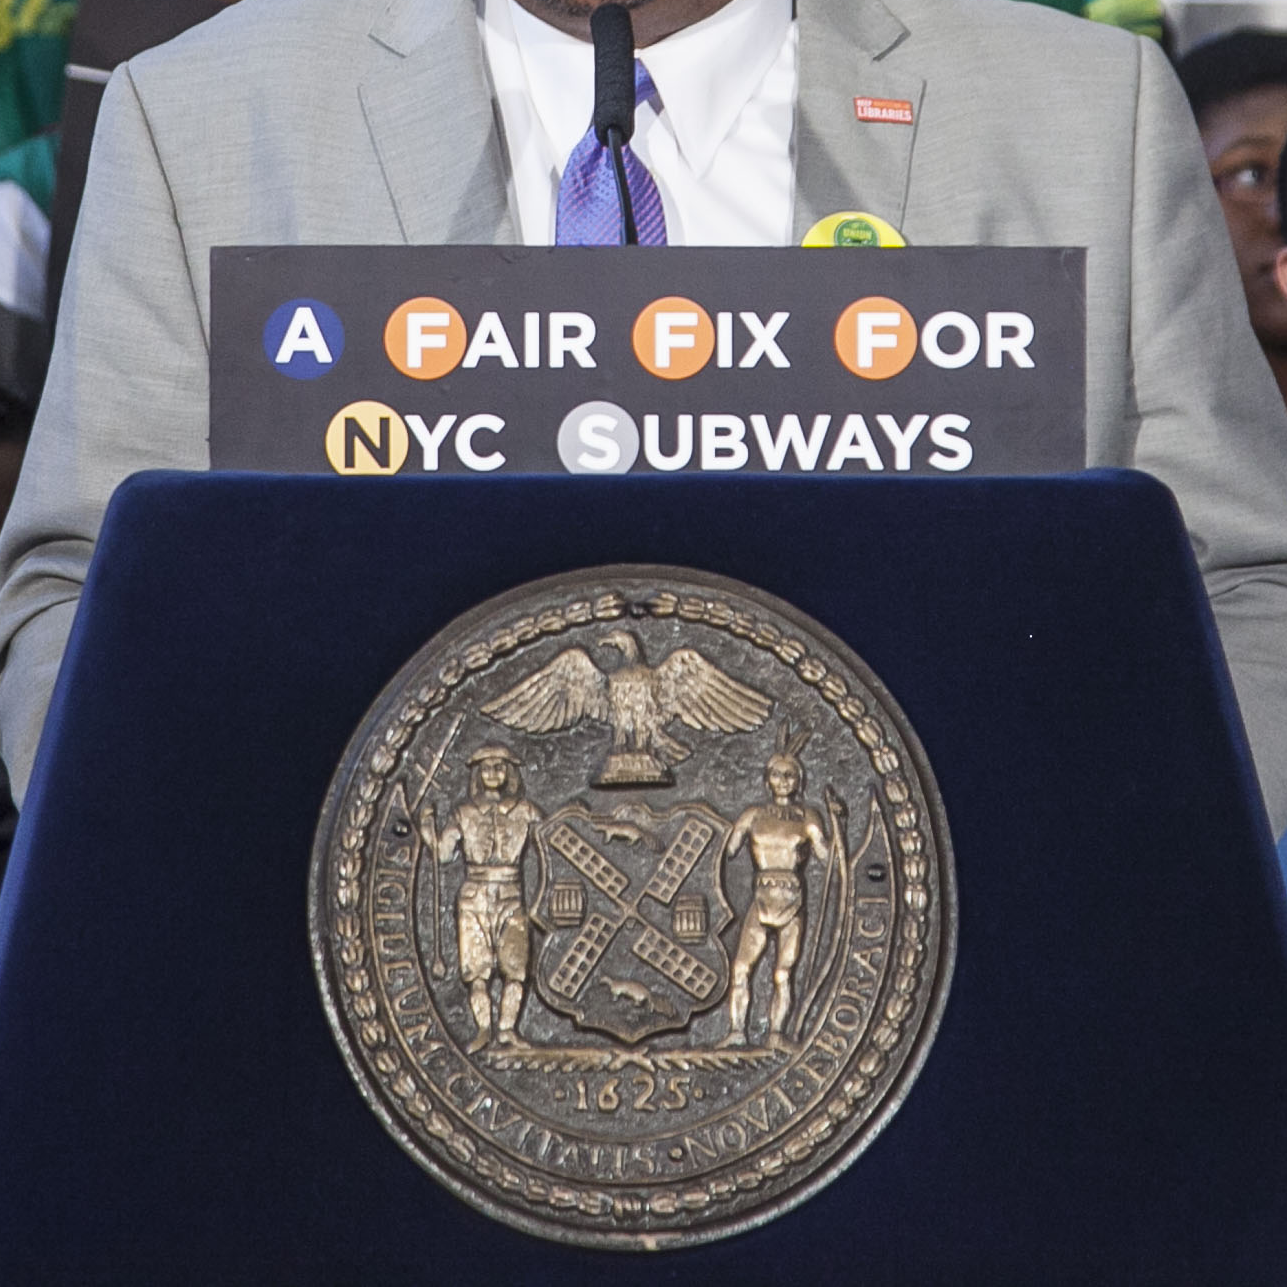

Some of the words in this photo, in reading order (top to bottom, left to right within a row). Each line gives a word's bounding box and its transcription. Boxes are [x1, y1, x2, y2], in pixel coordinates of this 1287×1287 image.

[857, 106, 912, 122] LIBRARIES
[275, 307, 333, 365] A
[407, 311, 597, 369] FAIR
[653, 311, 792, 369] FIX
[856, 311, 1036, 369] FOR
[342, 414, 507, 471] NYC
[577, 413, 975, 472] SUBWAYS
[683, 1083, 800, 1168] NOVI
[799, 896, 890, 1086] EBORACI
